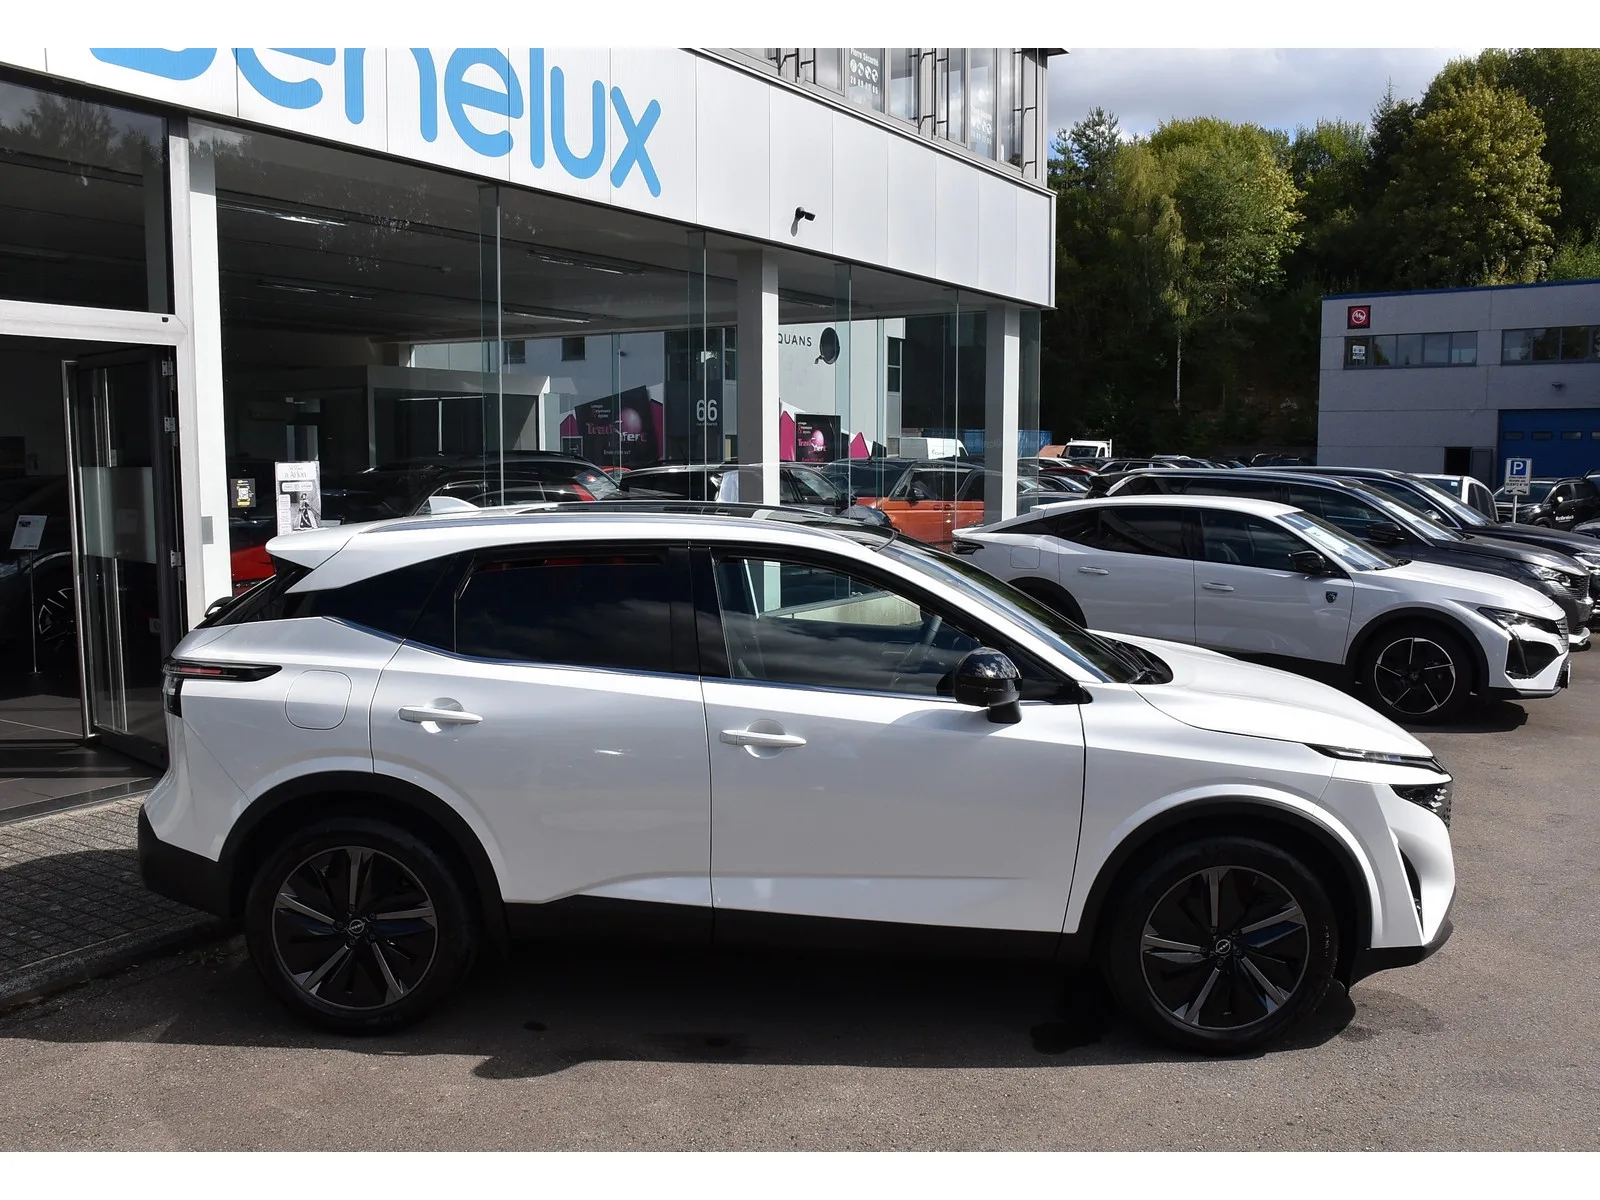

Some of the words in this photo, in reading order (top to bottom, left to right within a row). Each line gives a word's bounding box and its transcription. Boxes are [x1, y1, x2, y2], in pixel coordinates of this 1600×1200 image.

[90, 48, 662, 197] enelux
[696, 399, 718, 422] 66
[1513, 461, 1524, 475] P
